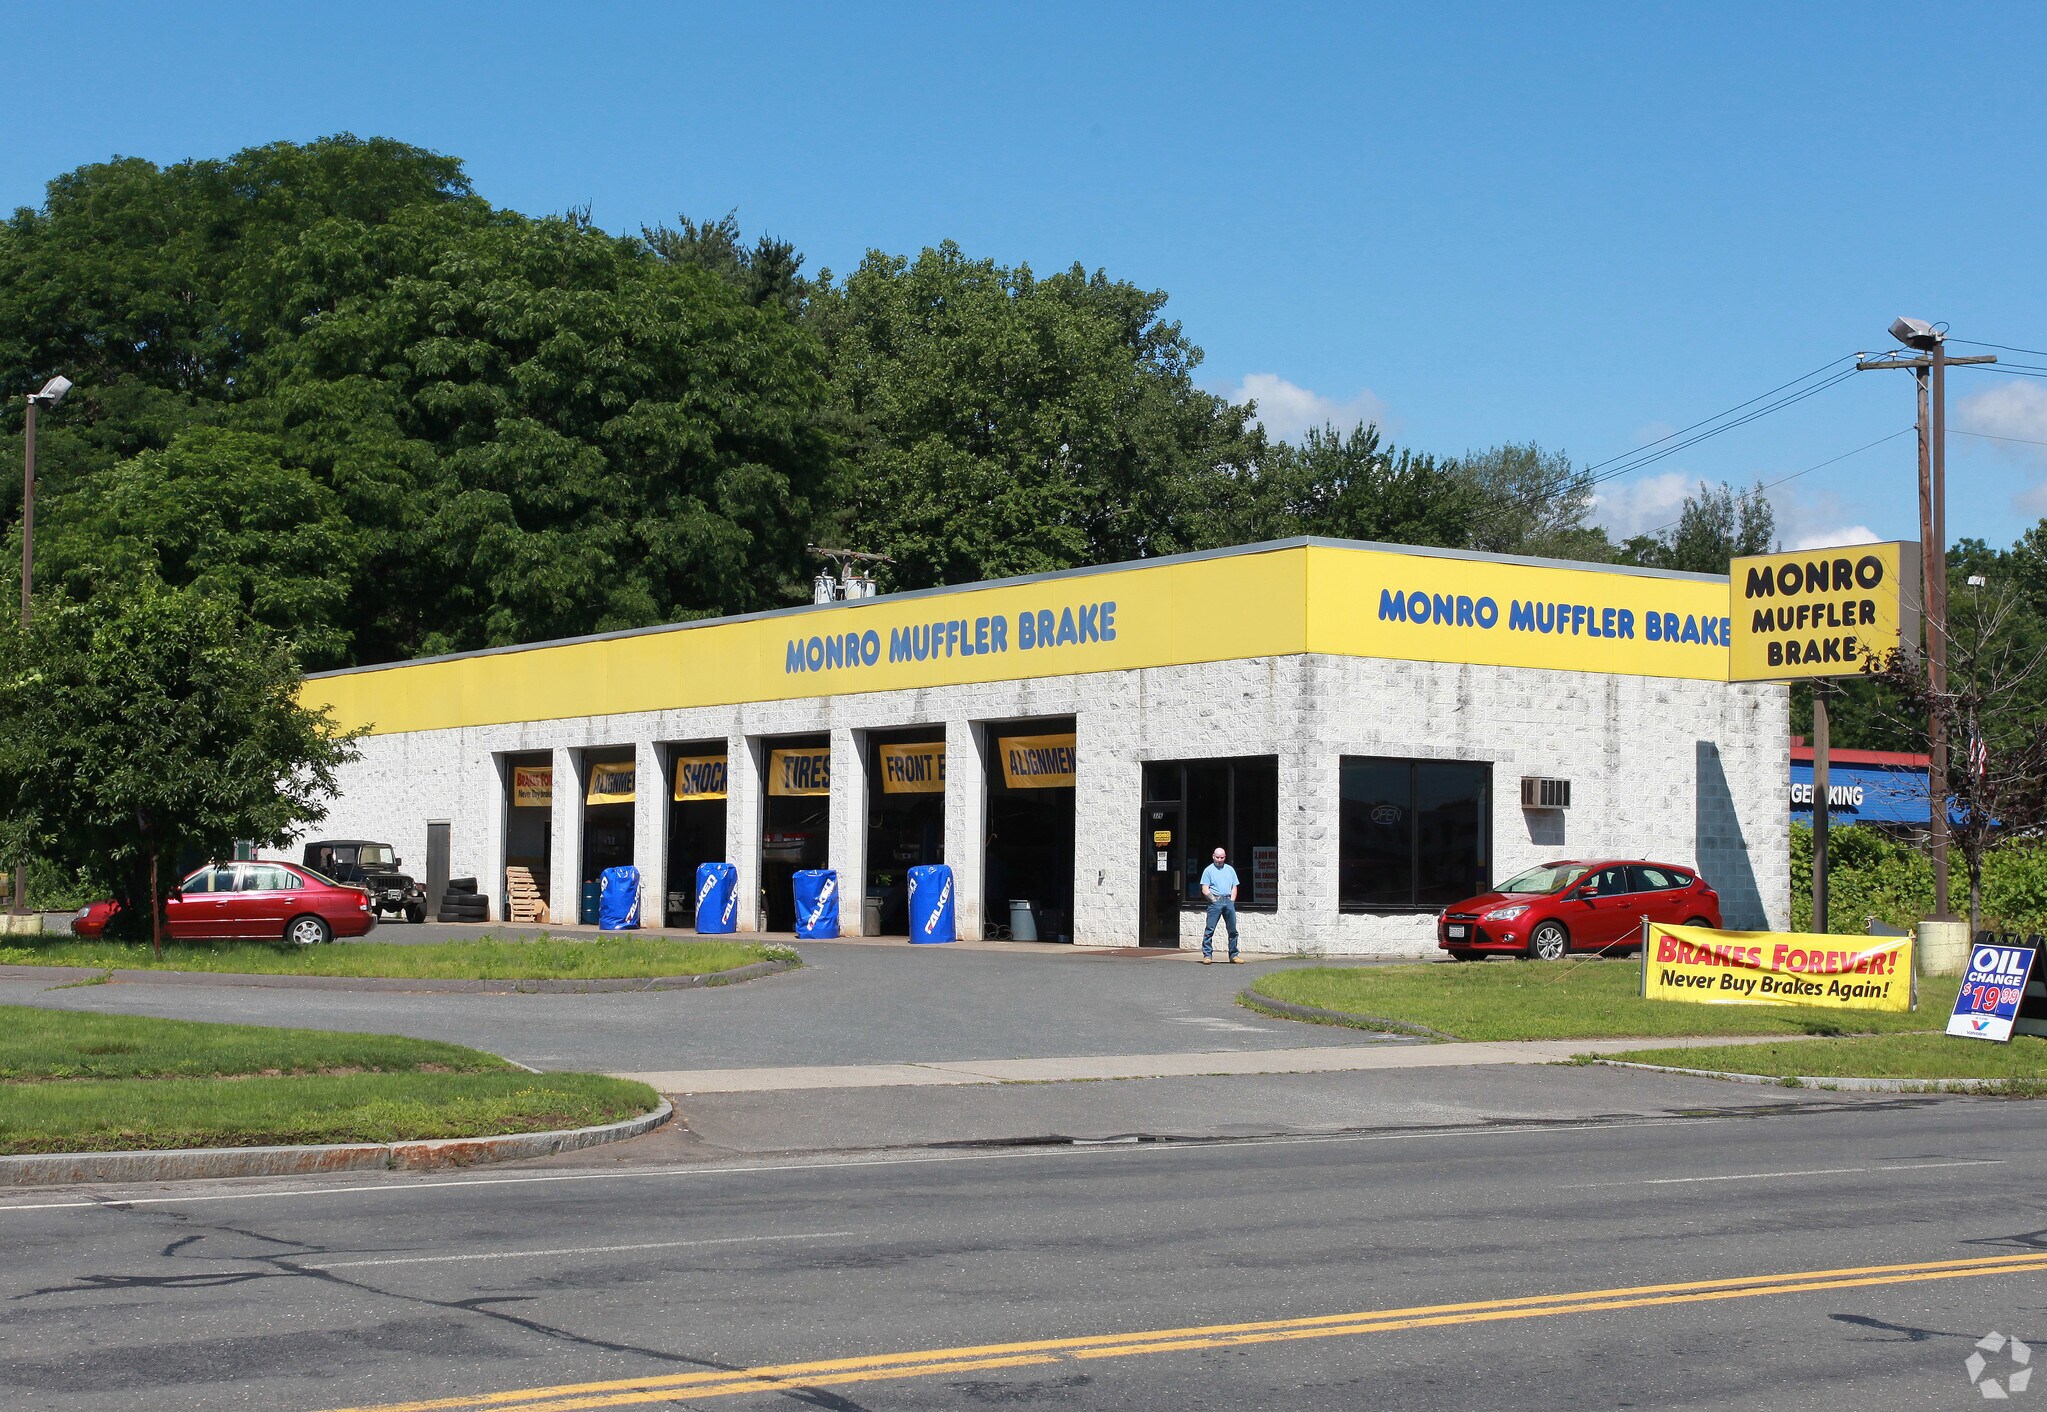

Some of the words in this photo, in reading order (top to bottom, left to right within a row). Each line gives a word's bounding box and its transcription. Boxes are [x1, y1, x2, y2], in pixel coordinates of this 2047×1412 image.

[1745, 555, 1884, 599] MONRO
[1378, 588, 1499, 630] MONRO
[1508, 599, 1635, 640] MUFFLER
[1645, 610, 1731, 647] BRAKE
[1751, 599, 1876, 634] MUFFLER
[785, 629, 881, 674] MONRO
[889, 614, 1008, 664] MUFFLER
[1018, 601, 1117, 650] BRAKE
[1767, 636, 1858, 667] BRAKE
[783, 755, 830, 788] TIRES
[886, 754, 933, 782] FRONT
[1791, 783, 1815, 804] GE
[1828, 785, 1863, 805] KING
[1371, 808, 1402, 822] OPEN
[806, 878, 836, 931] FALKEN
[1656, 935, 1762, 970] BRAKES
[1771, 944, 1898, 976] FOREVER!
[1973, 948, 2024, 975] OIL
[1660, 969, 1715, 989] Never
[1719, 974, 1757, 997] Buy
[1760, 975, 1823, 996] Brakes
[1827, 980, 1890, 1002] Again!
[1968, 971, 2022, 986] CHANGE
